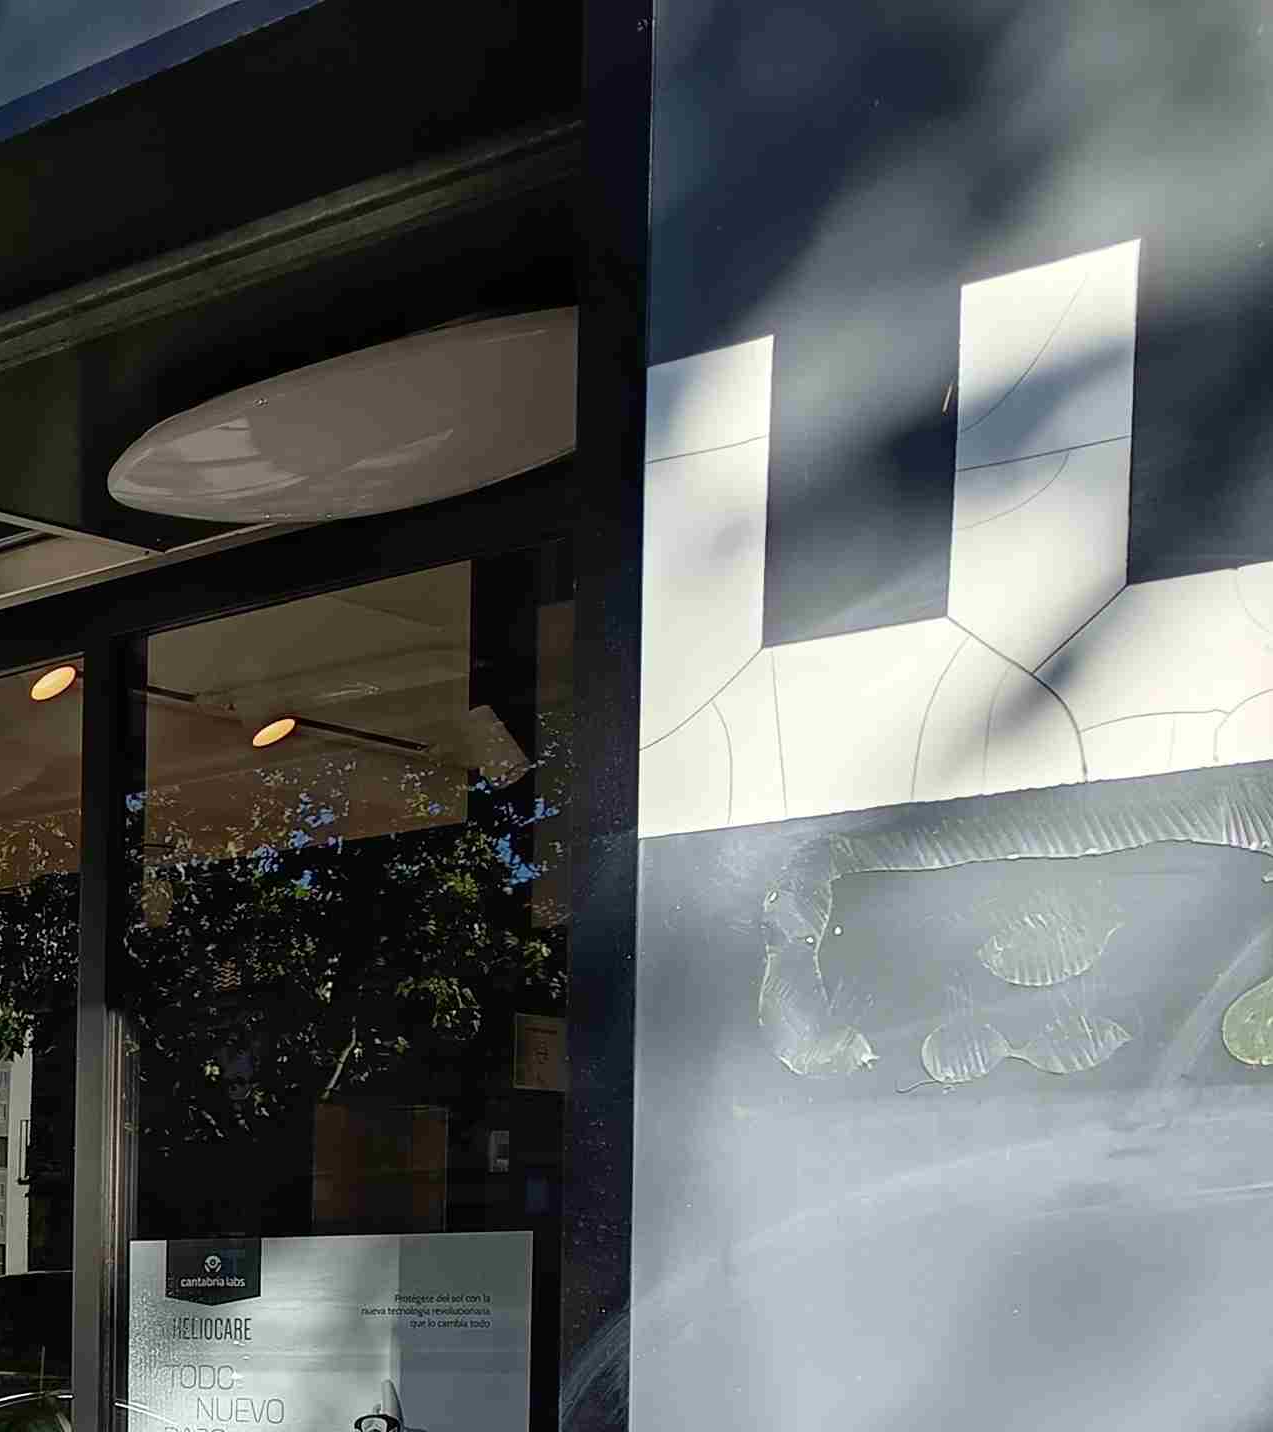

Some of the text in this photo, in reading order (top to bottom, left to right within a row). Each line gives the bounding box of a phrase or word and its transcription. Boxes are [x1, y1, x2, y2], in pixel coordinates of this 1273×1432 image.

[180, 1276, 246, 1288] cantabria labs
[172, 1317, 252, 1341] HELIOCARE
[470, 1319, 491, 1328] todo
[163, 1364, 235, 1390] TODO
[196, 1397, 285, 1424] NUEVO
